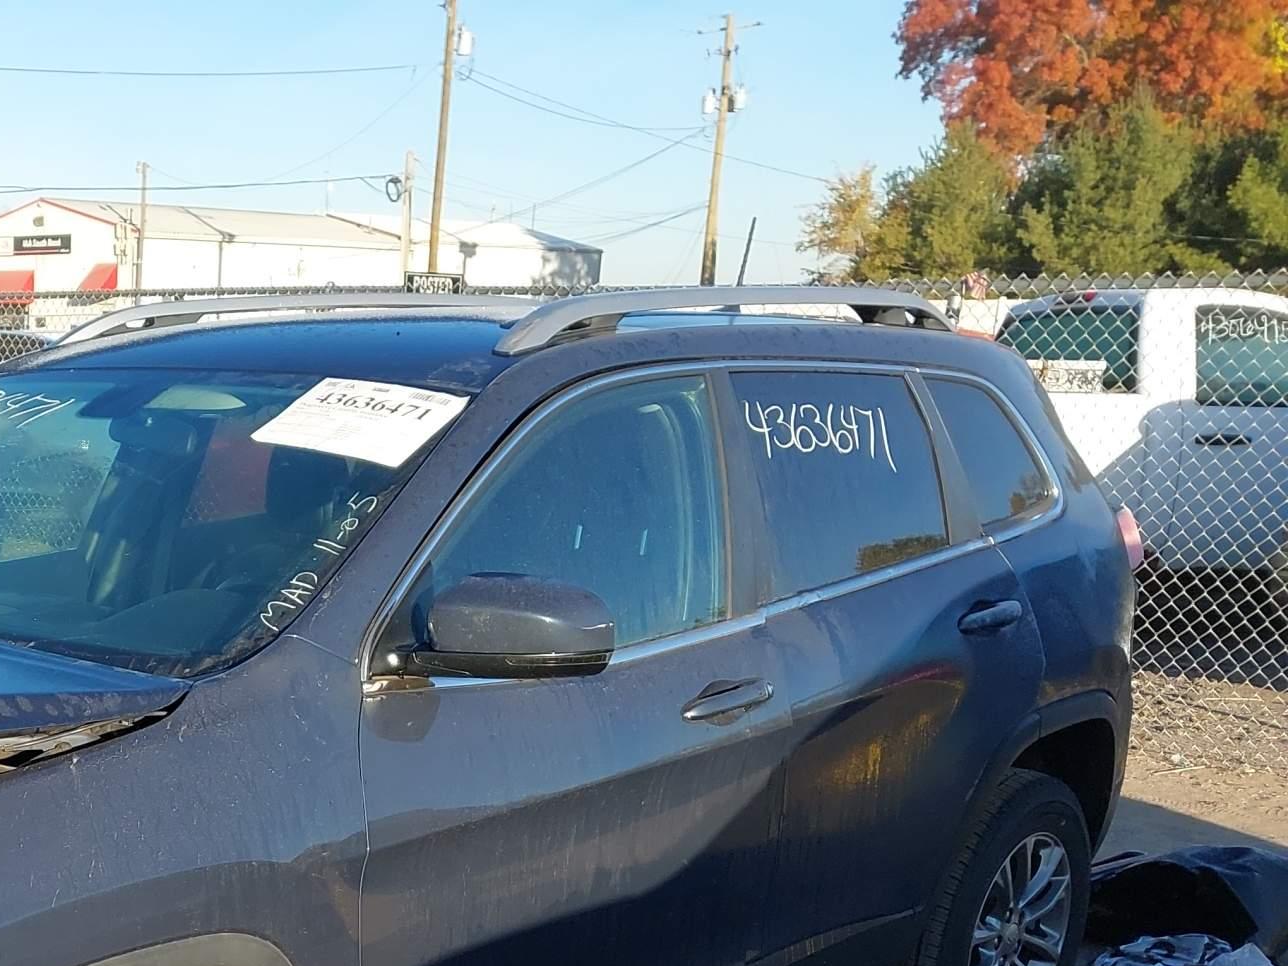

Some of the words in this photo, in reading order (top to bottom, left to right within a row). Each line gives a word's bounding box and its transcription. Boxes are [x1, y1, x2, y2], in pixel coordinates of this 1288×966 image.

[315, 391, 432, 421] 43636471
[742, 400, 897, 472] 43636471
[260, 571, 318, 631] MAD
